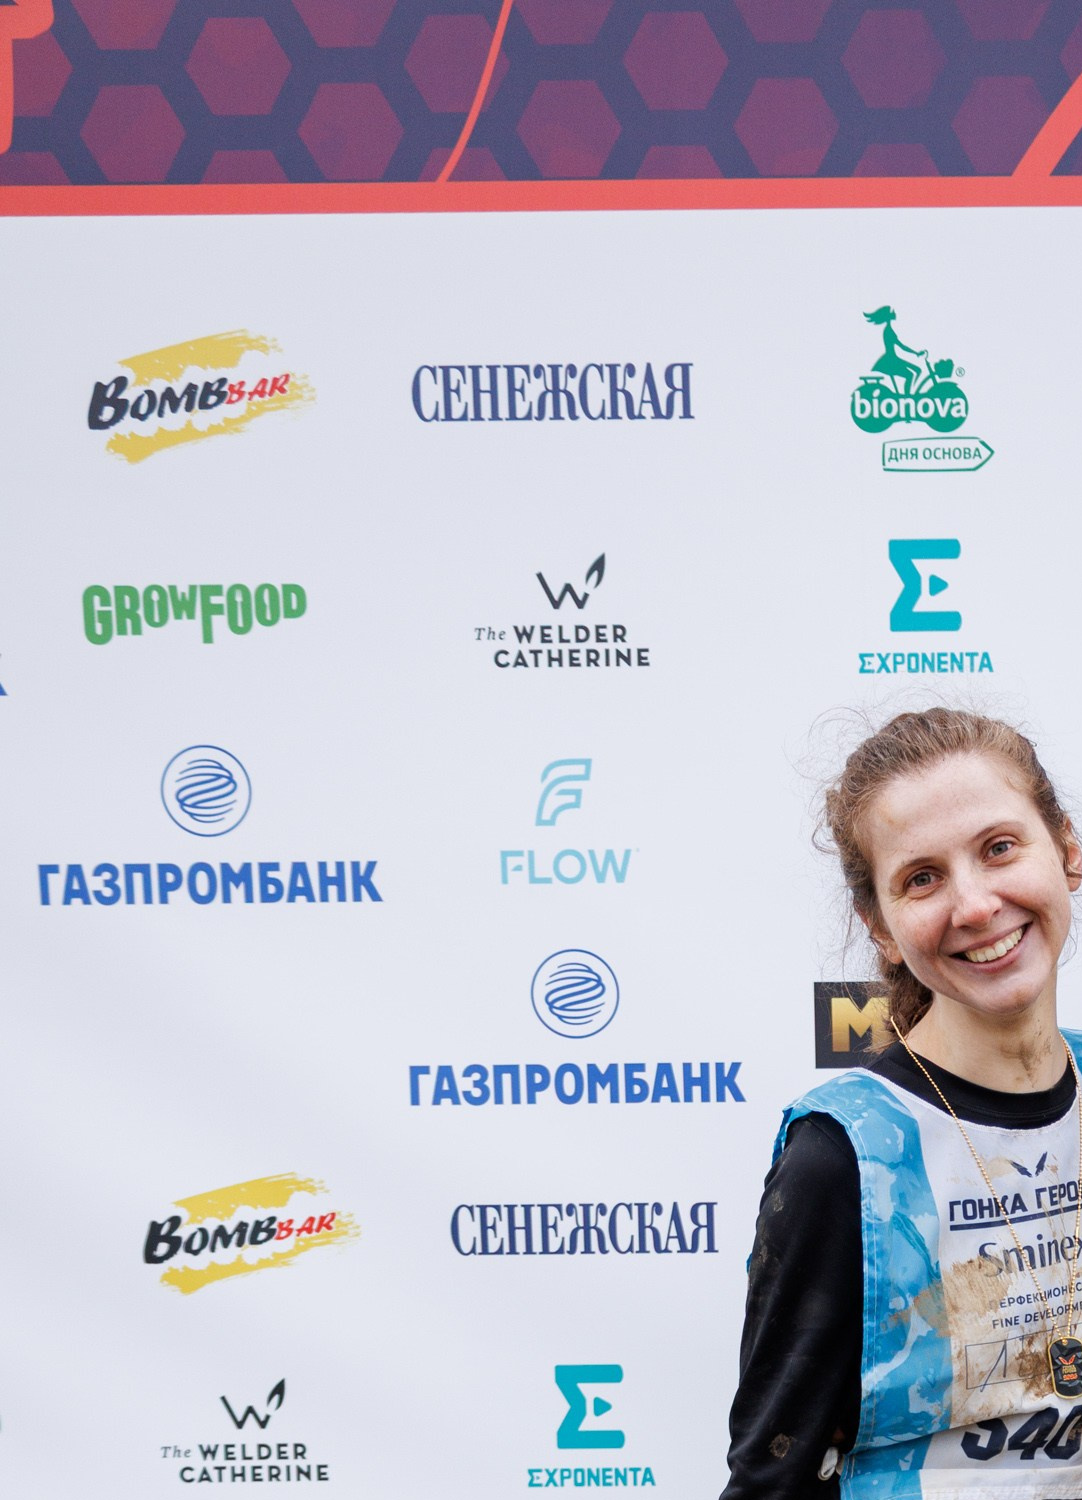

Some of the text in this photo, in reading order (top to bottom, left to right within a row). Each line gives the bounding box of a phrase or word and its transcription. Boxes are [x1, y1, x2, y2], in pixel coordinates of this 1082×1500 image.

[411, 361, 696, 423] СЕНЕЖСКАЯ
[853, 390, 967, 419] bionova
[887, 446, 983, 463] ДНЯ ОСНОВА
[82, 583, 307, 646] GROWFOOD
[475, 623, 628, 645] The WELDER
[493, 647, 651, 668] CATHERINE
[500, 848, 632, 885] FLOW
[38, 860, 384, 907] ГАЗПРОМБАНК
[409, 1061, 747, 1107] ГАЗПРОМБАНК
[948, 1193, 1028, 1222] ГОНКА
[449, 1201, 720, 1257] СЕНЕЖСКАЯ
[992, 1315, 1020, 1330] FINE
[160, 1442, 308, 1462] The WELDER
[179, 1463, 330, 1484] CATHERINE
